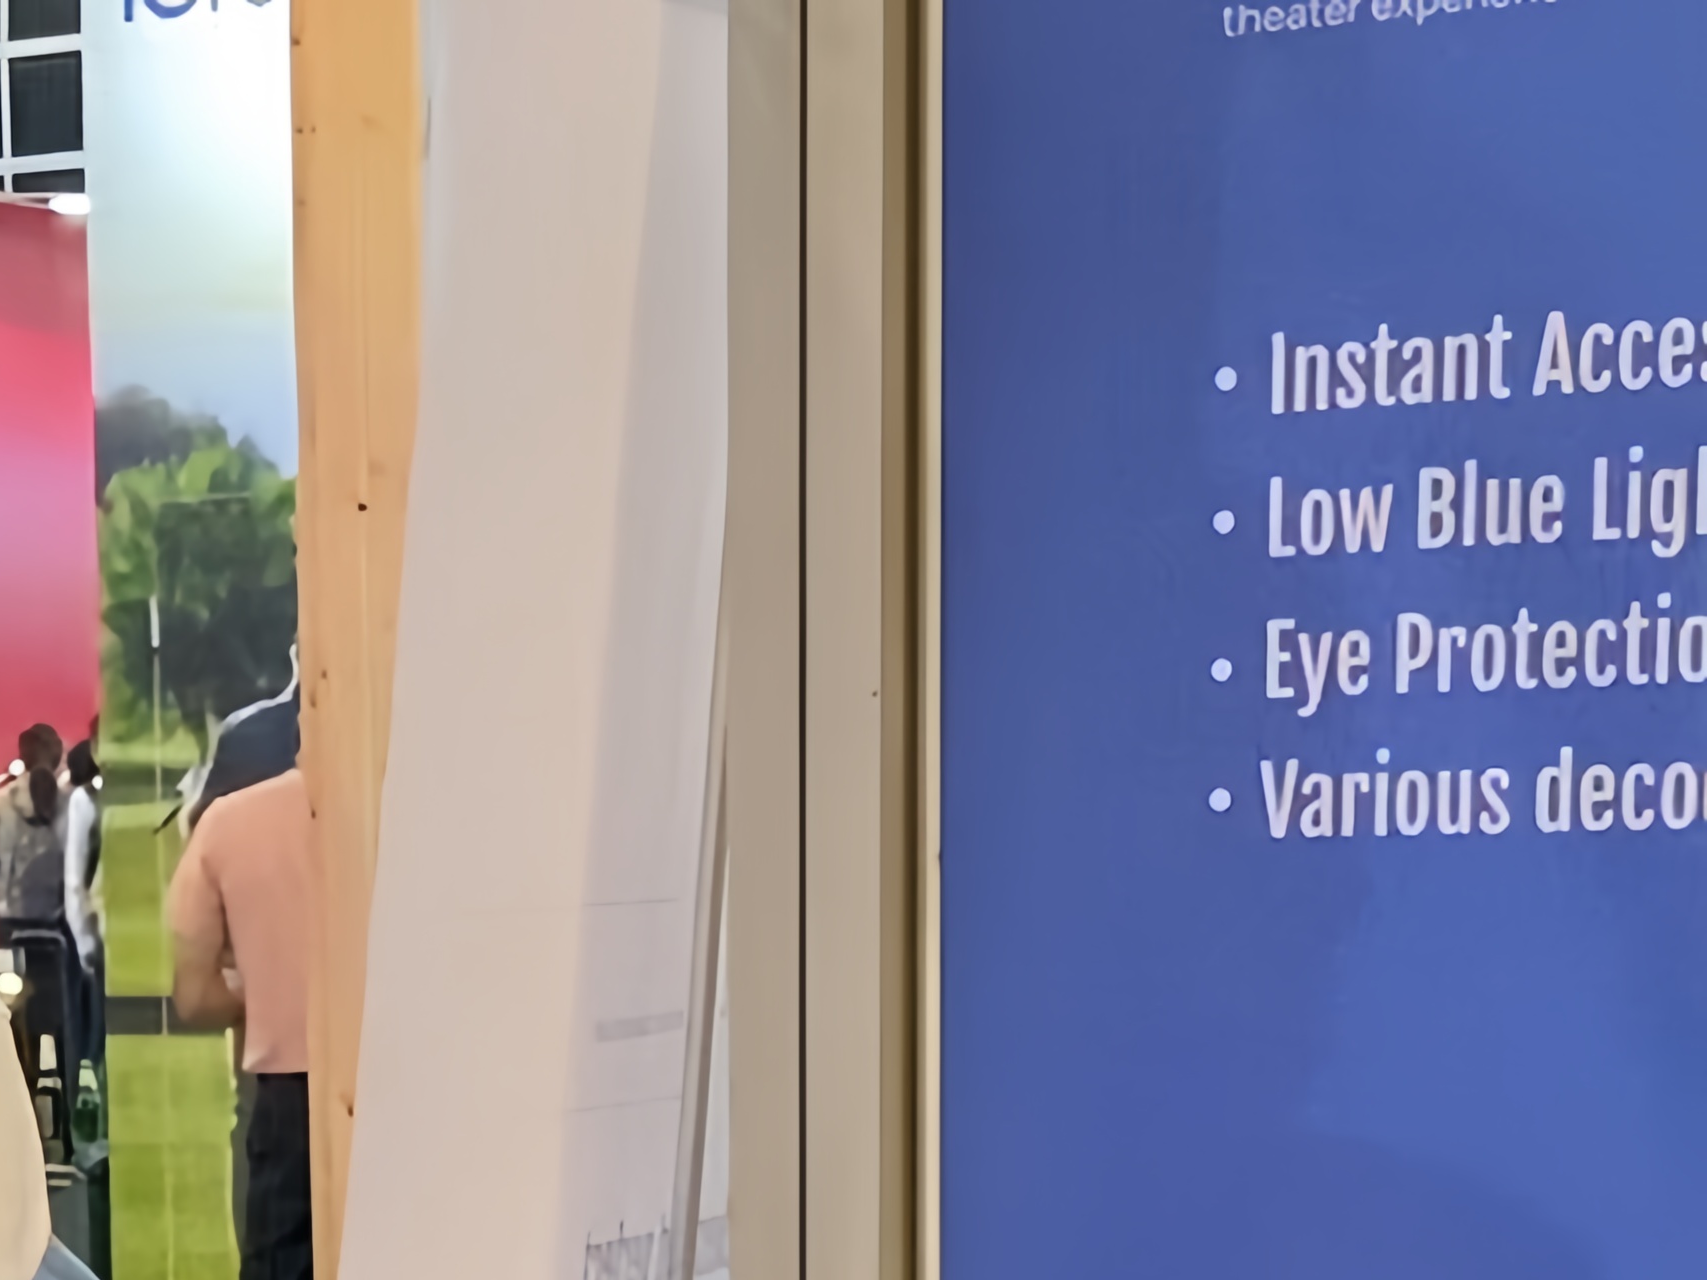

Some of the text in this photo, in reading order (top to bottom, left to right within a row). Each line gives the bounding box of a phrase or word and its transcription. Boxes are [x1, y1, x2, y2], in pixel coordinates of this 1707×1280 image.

[1223, 0, 1356, 37] theater
[1271, 313, 1513, 415] Instant
[1268, 475, 1394, 558] Low
[1417, 458, 1565, 549] Blue
[1266, 592, 1707, 717] Eye Protectio
[1260, 745, 1707, 839] Various deco
